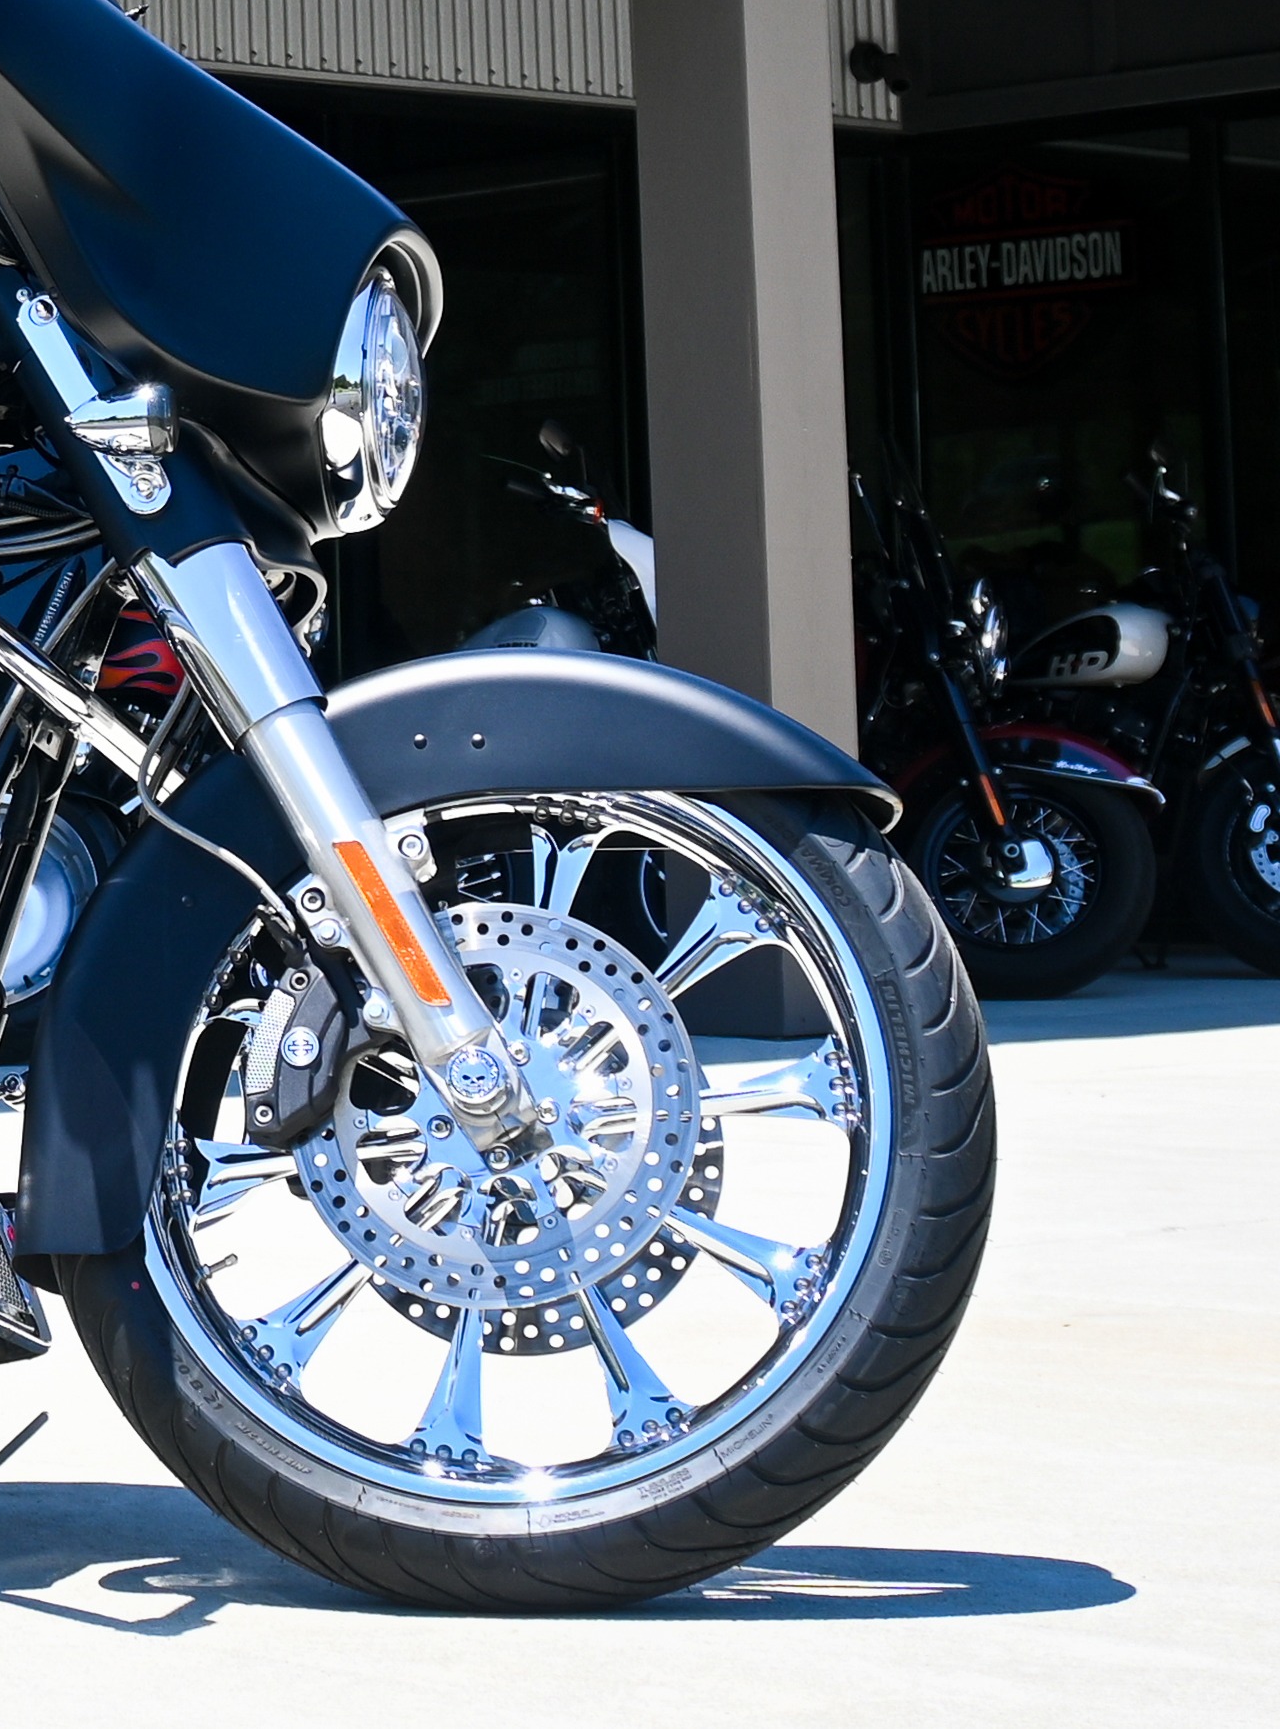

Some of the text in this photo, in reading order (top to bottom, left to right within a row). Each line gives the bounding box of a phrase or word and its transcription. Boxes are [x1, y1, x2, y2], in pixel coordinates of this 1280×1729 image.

[952, 175, 1068, 227] MOTOR
[921, 231, 1123, 294] ARLEY-DAVIDSON
[881, 984, 916, 1105] MICHELIN
